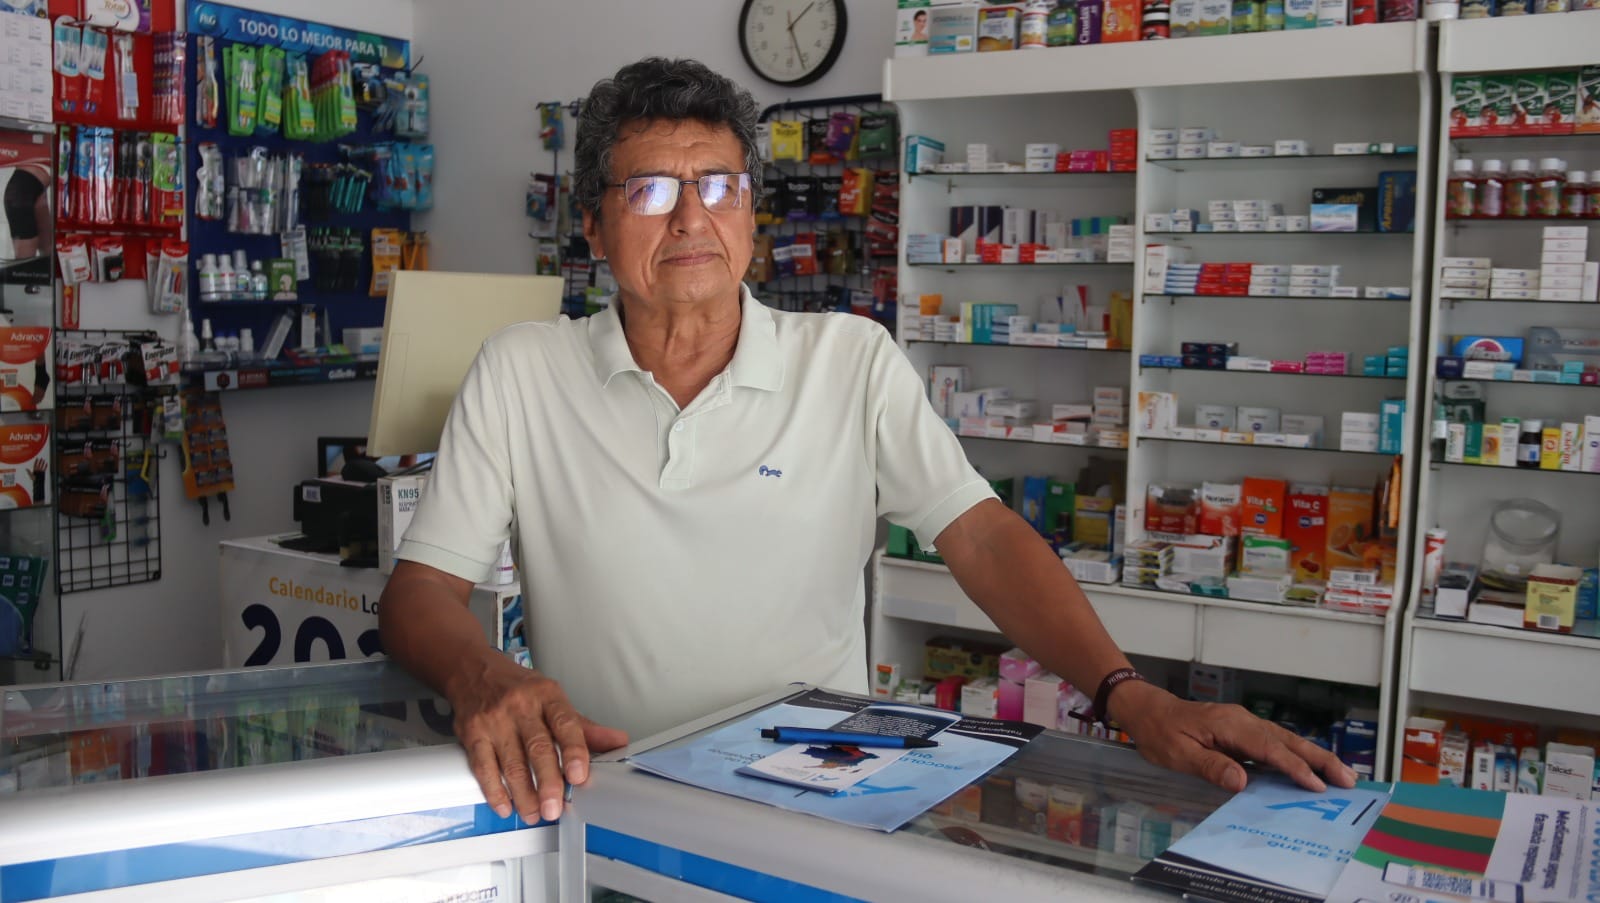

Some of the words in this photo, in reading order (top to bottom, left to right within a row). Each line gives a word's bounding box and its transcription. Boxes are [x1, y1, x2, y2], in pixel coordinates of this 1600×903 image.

[239, 18, 278, 39] TODO
[281, 26, 298, 42] LO
[301, 31, 343, 49] MEJOR
[344, 39, 376, 57] PARA
[376, 46, 388, 58] TI
[10, 332, 45, 343] Advance
[144, 345, 176, 362] Energizer
[9, 431, 42, 442] Advance
[397, 488, 420, 500] KN95
[1245, 495, 1264, 506] Vita
[1265, 498, 1274, 507] C
[1292, 498, 1311, 509] Vita
[1312, 501, 1321, 510] C
[269, 576, 360, 611] Calendario
[1226, 823, 1333, 852] ASOCOLDRO,
[1266, 840, 1301, 852] QUE
[1307, 850, 1329, 859] SE
[1162, 865, 1225, 886] Trabajando
[1226, 880, 1248, 891] por
